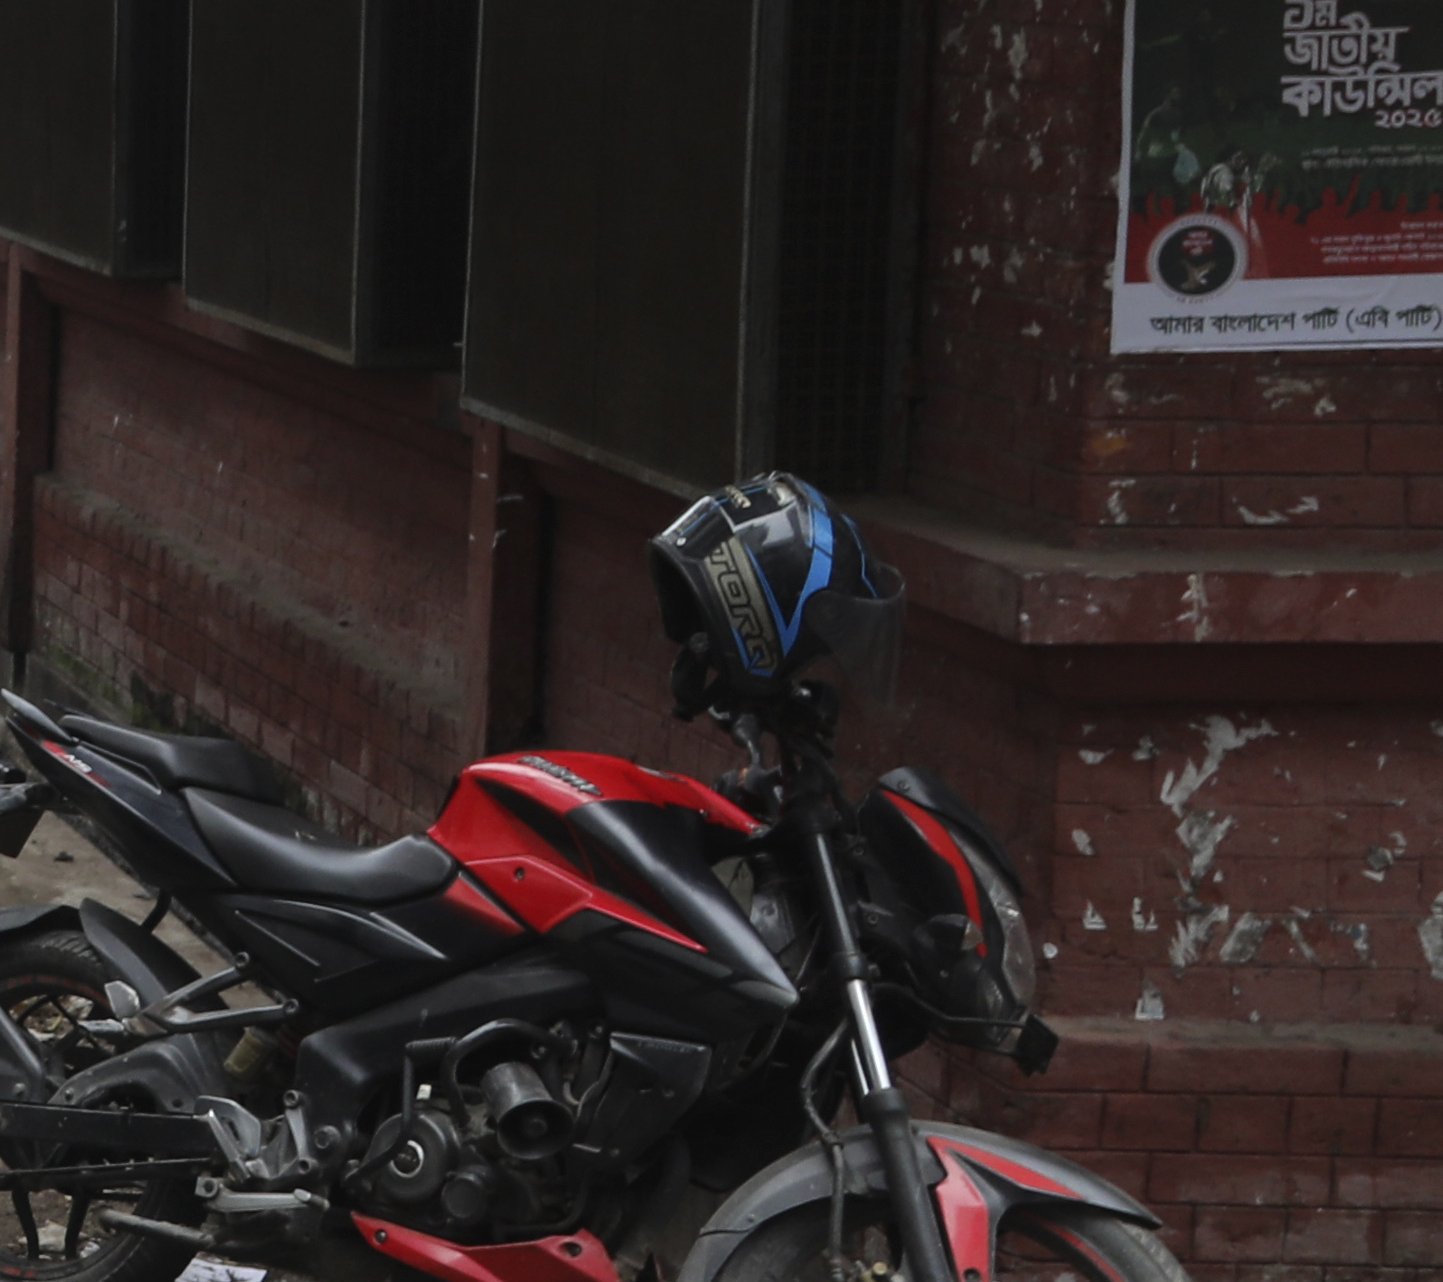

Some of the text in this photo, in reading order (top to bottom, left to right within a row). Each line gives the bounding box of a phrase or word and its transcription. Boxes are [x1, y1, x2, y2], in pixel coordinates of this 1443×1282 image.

[1282, 11, 1412, 71] জাতীয়
[1374, 109, 1443, 129] ২০২৫
[1150, 314, 1204, 334] আমার
[1212, 311, 1295, 332] বাংলাদেশ
[1302, 307, 1339, 329] পার্টি
